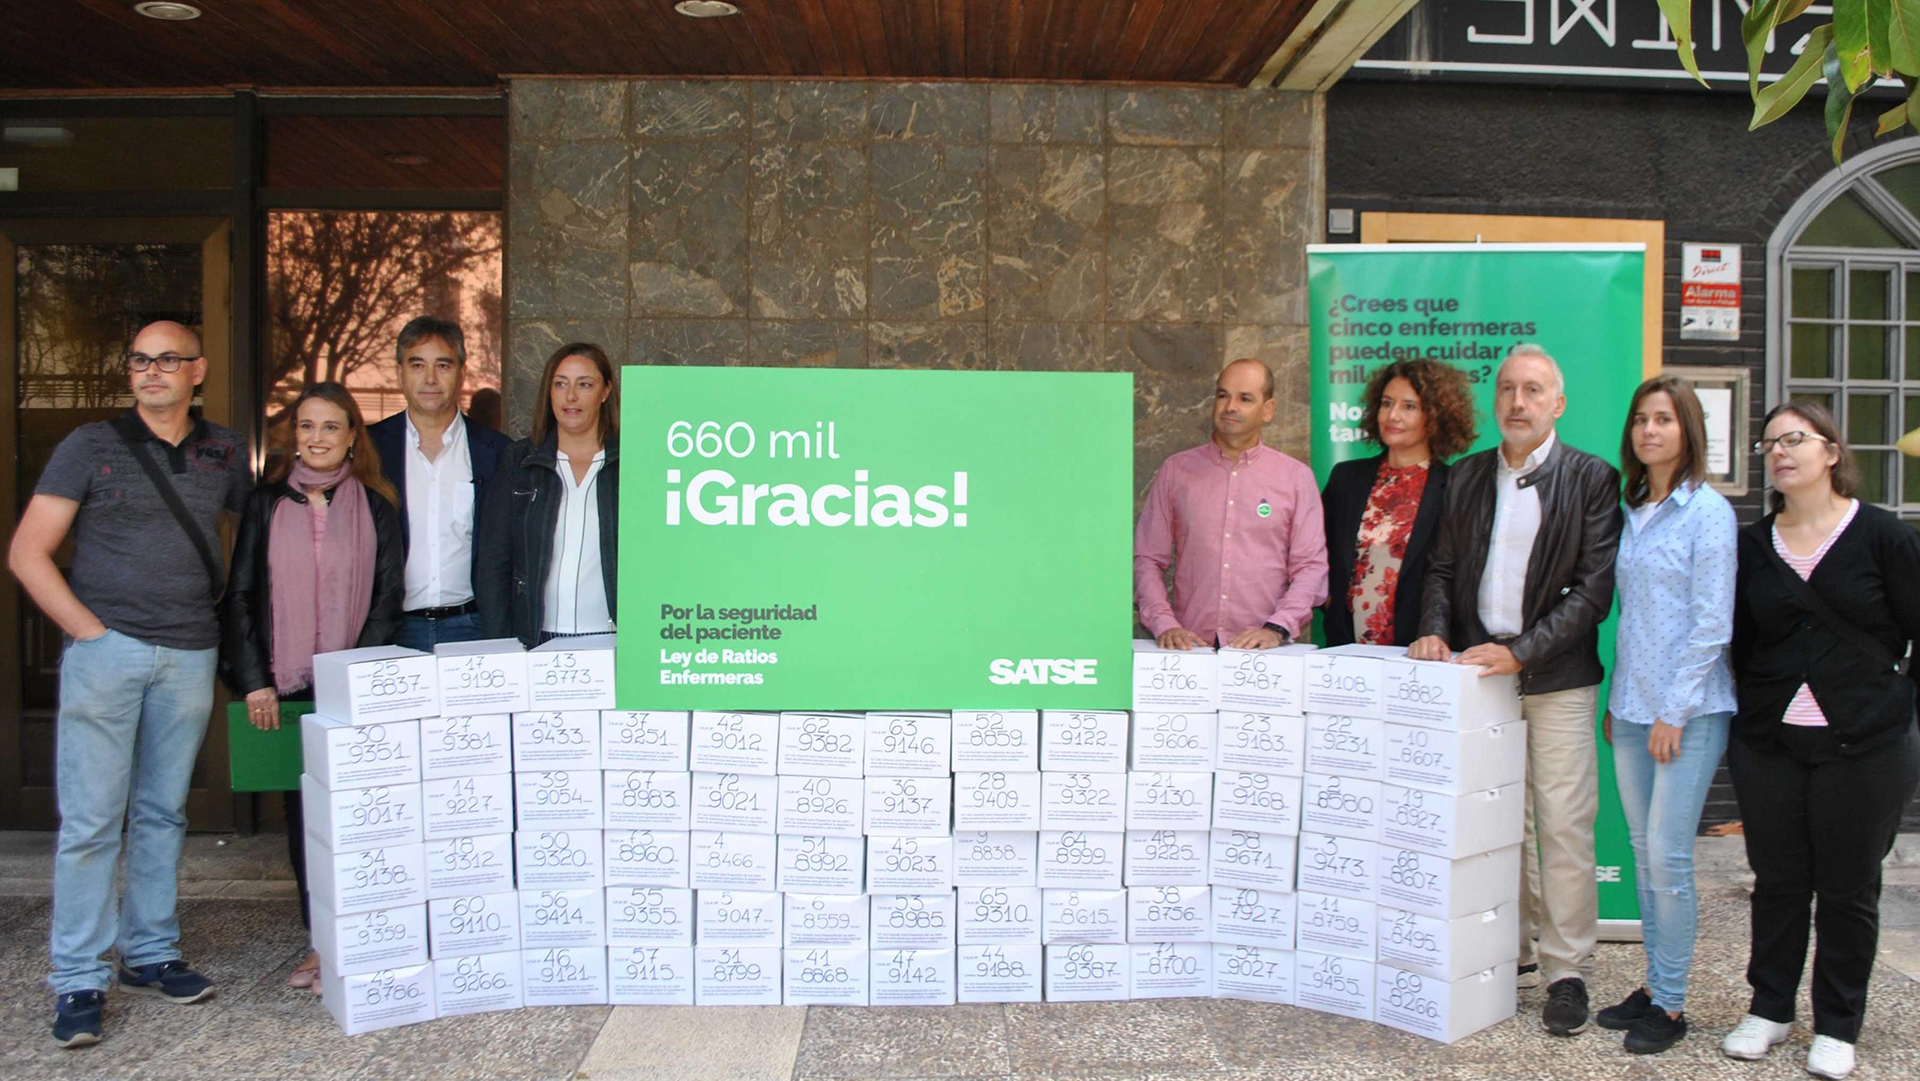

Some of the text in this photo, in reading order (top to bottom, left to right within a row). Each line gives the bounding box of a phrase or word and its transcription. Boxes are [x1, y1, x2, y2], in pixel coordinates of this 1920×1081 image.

[1685, 285, 1737, 299] Alarma
[1414, 299, 1459, 316] que
[1329, 319, 1536, 336] cinco enfermeras
[1329, 342, 1420, 365] pueden
[1427, 341, 1500, 360] cuidar
[666, 420, 840, 458] 660 mil
[666, 469, 968, 527] ¡Gracias!
[660, 603, 817, 624] Por la seguridad
[660, 624, 782, 644] del paciente
[552, 654, 576, 668] 13
[660, 649, 778, 667] Ley de Ratios
[1160, 655, 1180, 671] 12
[1240, 654, 1266, 672] 26
[373, 661, 400, 678] 25
[660, 669, 764, 685] Enfermeras
[989, 658, 1098, 685] SATSE
[1409, 666, 1418, 683] 1
[446, 717, 472, 734] 27
[538, 712, 564, 728] 43
[627, 713, 649, 729] 37
[717, 715, 743, 731] 42
[803, 718, 830, 733] 62
[889, 720, 917, 736] 63
[976, 714, 1003, 729] 52
[1069, 714, 1097, 729] 35
[1157, 715, 1187, 732] 20
[1242, 714, 1270, 732] 23
[1327, 716, 1351, 733] 22
[354, 726, 386, 744] 30
[453, 778, 474, 796] 14
[539, 771, 569, 788] 39
[803, 779, 831, 796] 40
[891, 780, 916, 796] 36
[979, 773, 1005, 789] 28
[1065, 774, 1091, 788] 33
[1152, 773, 1175, 788] 21
[1327, 776, 1341, 792] 2
[360, 787, 390, 806] 32
[1403, 790, 1423, 808] 19
[540, 832, 570, 849] 50
[802, 837, 826, 854] 51
[892, 838, 917, 854] 45
[1322, 836, 1337, 856] 3
[360, 850, 386, 868] 34
[1398, 851, 1419, 870] 68
[541, 892, 568, 908] 56
[631, 889, 663, 905] 55
[721, 892, 732, 904] 5
[813, 897, 824, 910] 6
[453, 896, 485, 916] 60
[366, 911, 388, 927] 15
[1395, 910, 1417, 927] 24
[544, 950, 570, 966] 46
[632, 948, 659, 963] 57
[718, 950, 742, 963] 31
[807, 949, 830, 966] 41
[893, 950, 916, 968] 47
[458, 956, 482, 976] 61
[1320, 957, 1342, 974] 16
[371, 970, 395, 986] 49
[1396, 972, 1422, 993] 69
